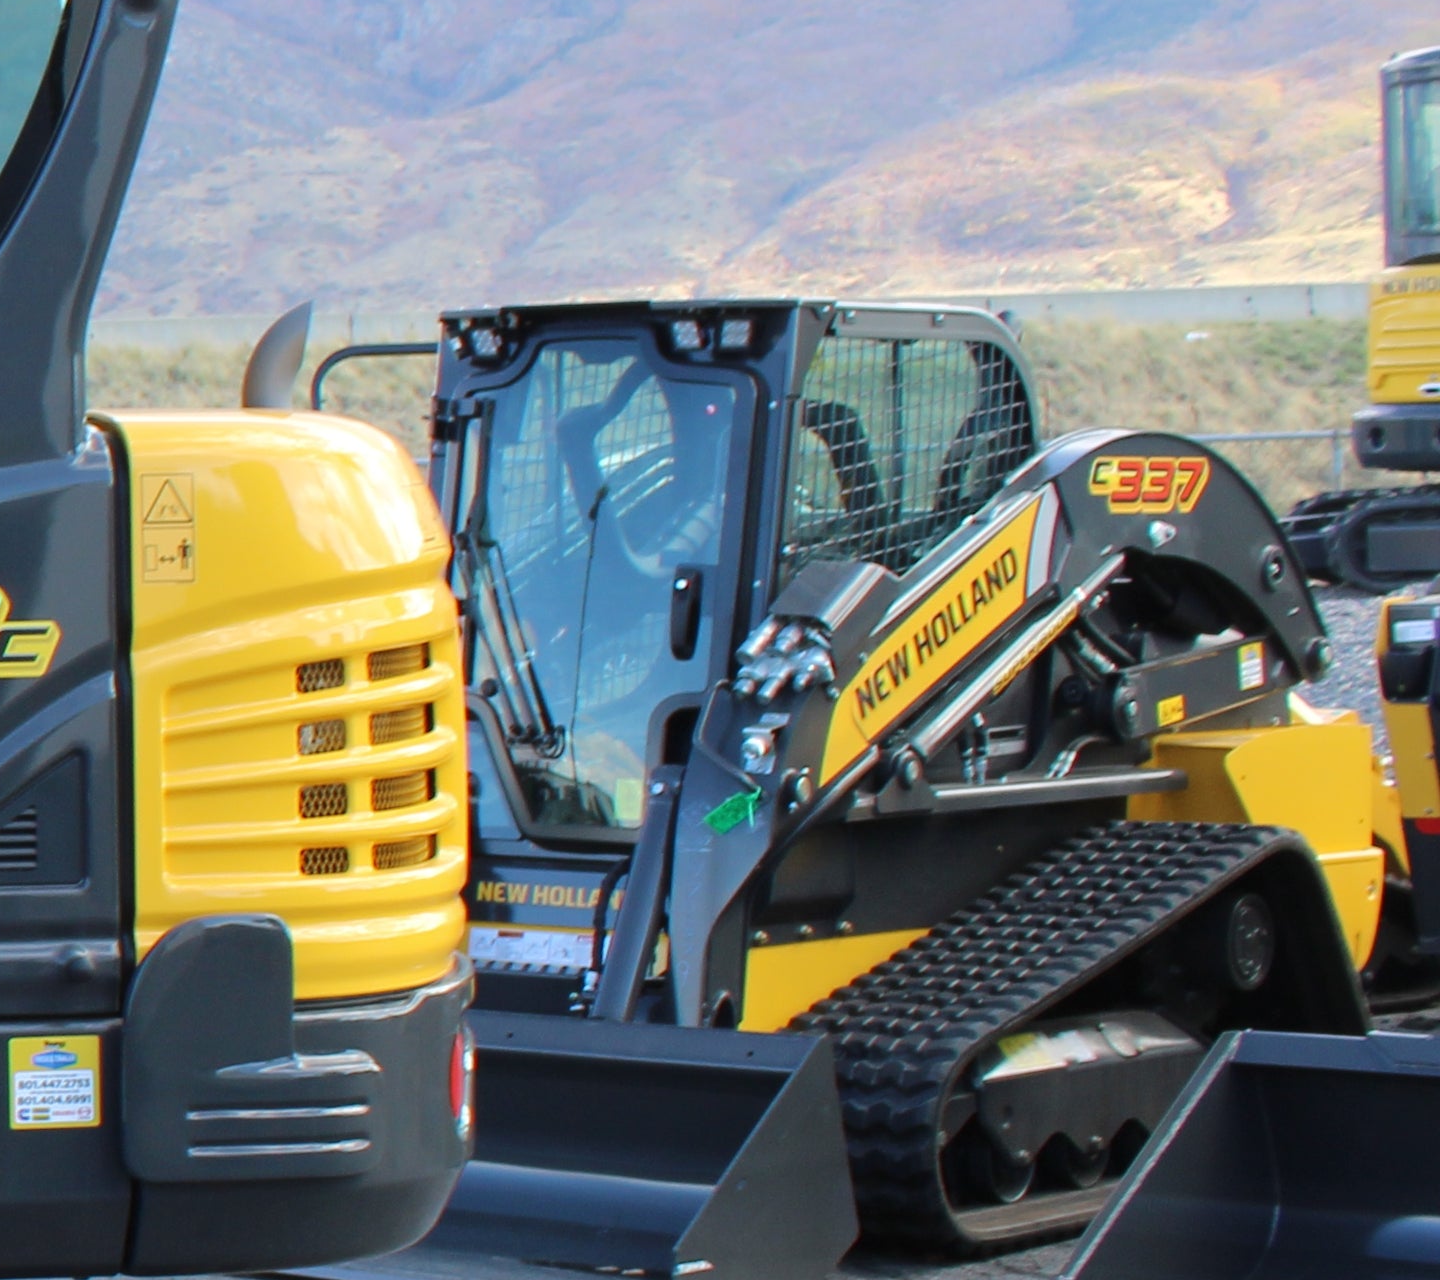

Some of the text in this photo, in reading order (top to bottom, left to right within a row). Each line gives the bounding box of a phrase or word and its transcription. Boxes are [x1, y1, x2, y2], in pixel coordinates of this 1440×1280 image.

[1090, 457, 1207, 509] C337
[854, 643, 910, 720] NEW
[912, 547, 1019, 667] HOLLAND
[476, 880, 529, 905] NEW
